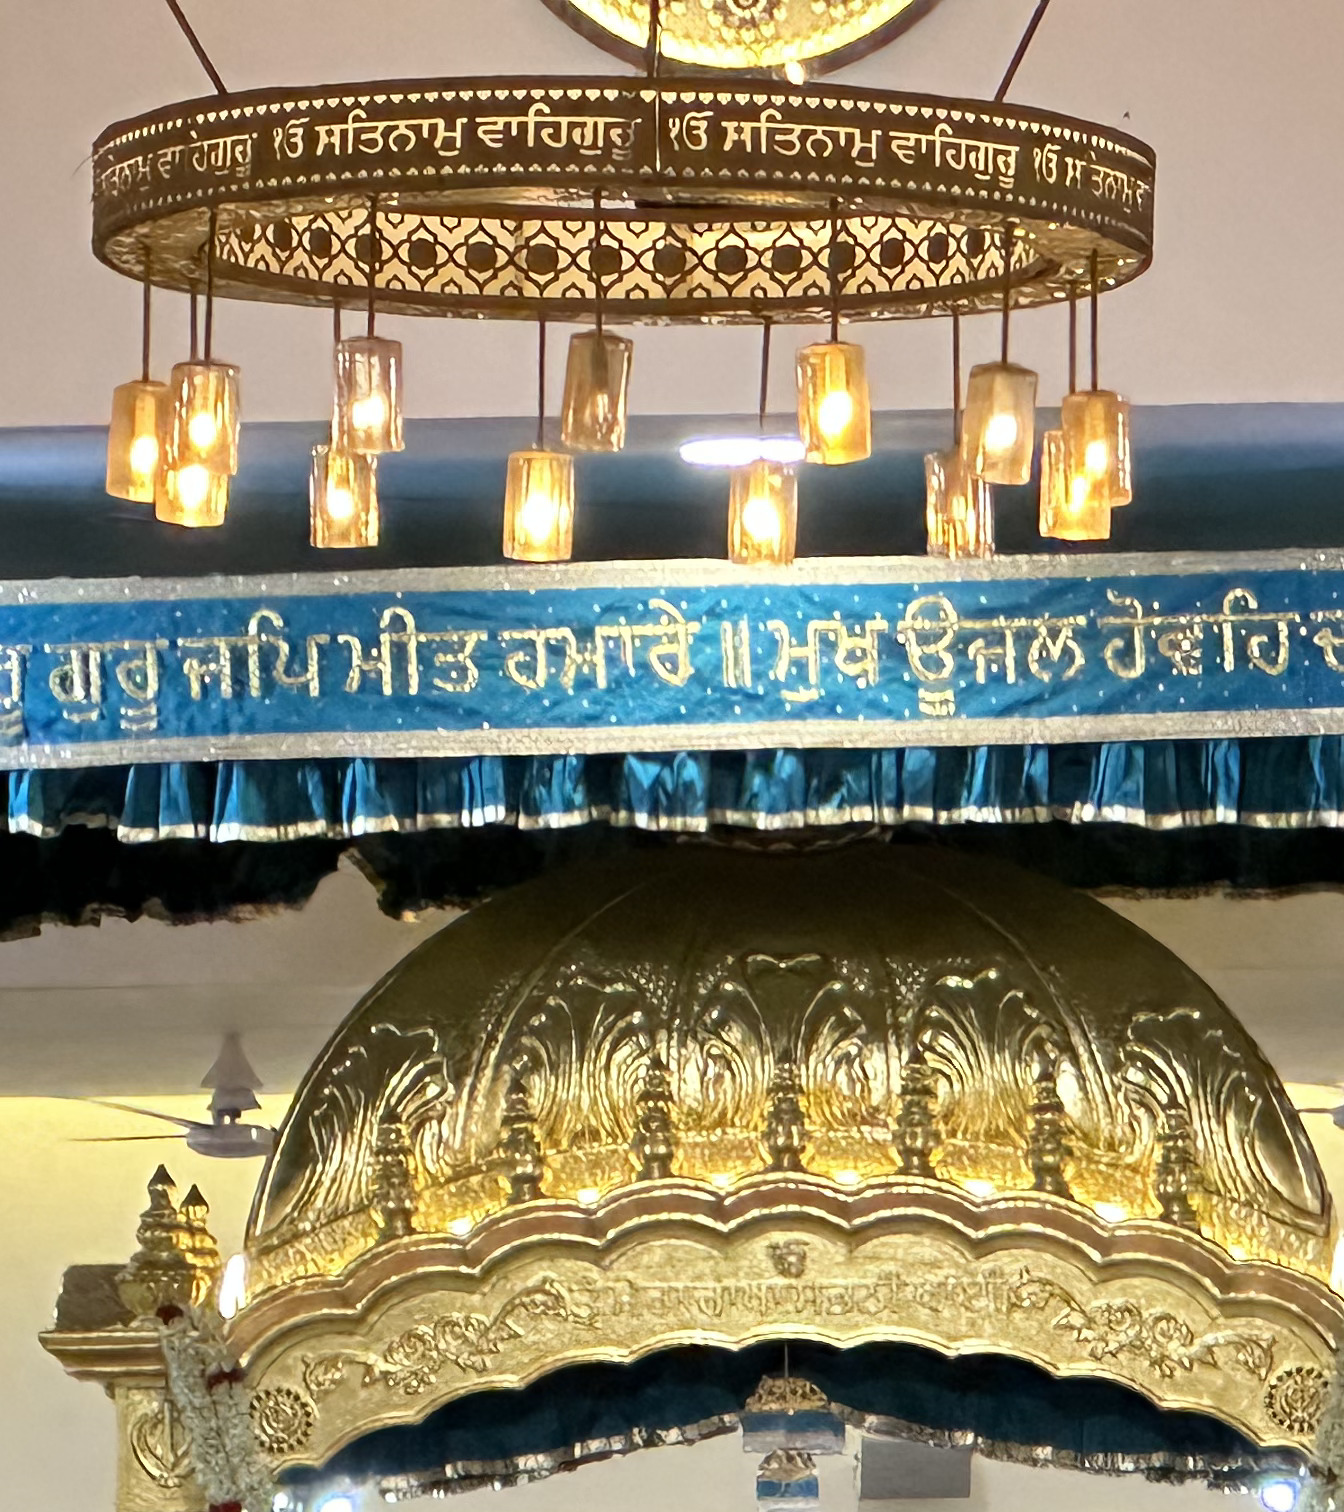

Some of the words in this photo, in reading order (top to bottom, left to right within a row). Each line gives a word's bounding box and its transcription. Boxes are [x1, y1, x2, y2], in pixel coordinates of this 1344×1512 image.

[314, 108, 468, 157] ਸਤਿਨਾਮੁ
[475, 102, 642, 160] ਵਾਹਿਗੁਰੂ
[721, 108, 881, 167] ਸਤਿਨਾਮੁ
[889, 123, 1020, 189] ਵਾਹਿਗੁਰੂ
[43, 638, 170, 732] ਗੁਰੂ
[177, 609, 331, 700] ਜਪਿ
[337, 606, 488, 696] ਮੀਤ
[498, 598, 701, 691] ਹਮਾਰੇ
[766, 619, 889, 703] ਮੁਖ
[897, 595, 1086, 716] ਊਜਲ
